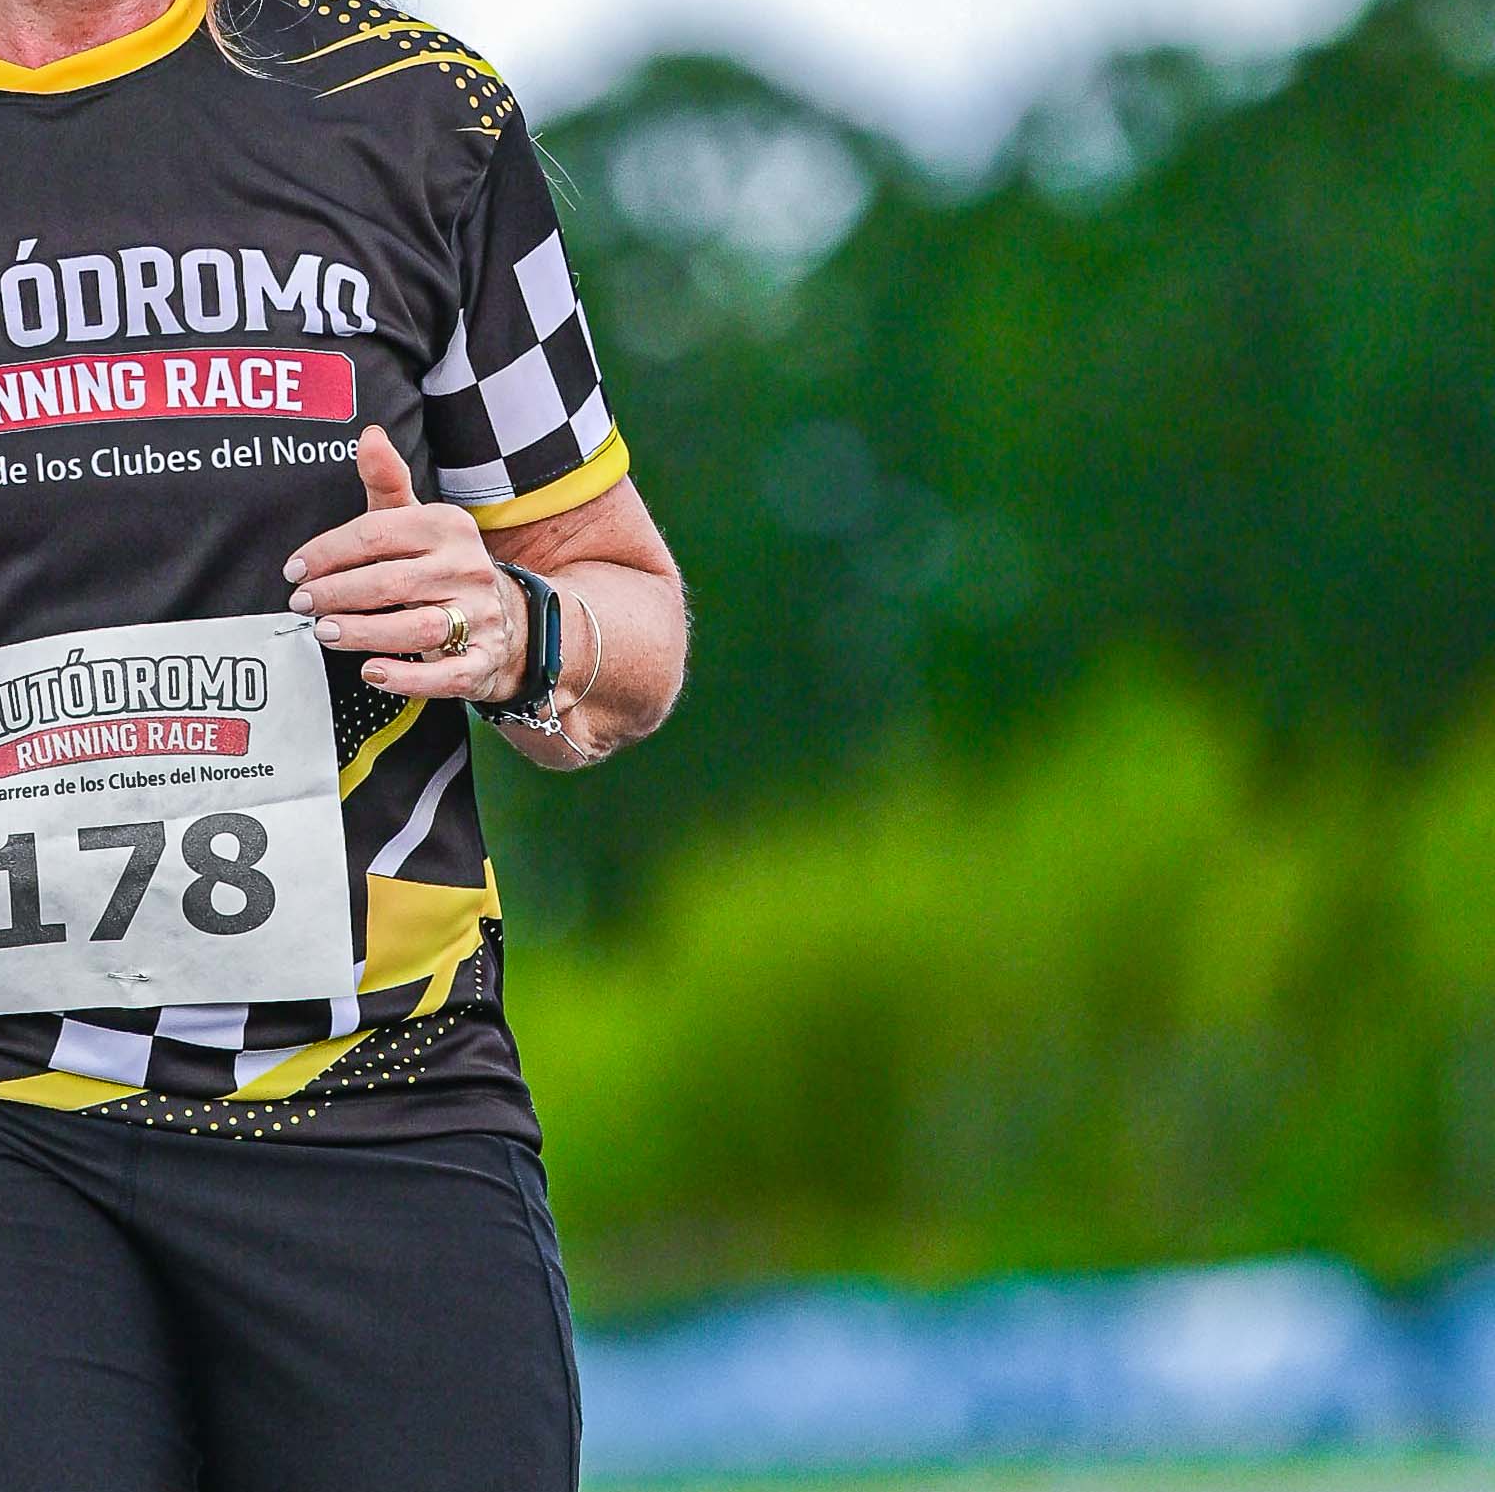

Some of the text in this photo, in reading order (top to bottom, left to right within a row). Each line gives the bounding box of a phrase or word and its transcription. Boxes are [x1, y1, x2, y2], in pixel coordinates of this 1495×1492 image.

[164, 357, 304, 413] RACE
[36, 452, 84, 483] los
[90, 444, 202, 478] Clubes
[211, 437, 263, 470] del
[271, 434, 359, 466] Noroe
[16, 721, 219, 771] RUNNING RACE
[54, 778, 77, 796] de
[80, 776, 105, 793] los
[109, 771, 167, 790] Clubes
[171, 767, 196, 784] del
[201, 762, 275, 782] Noroeste
